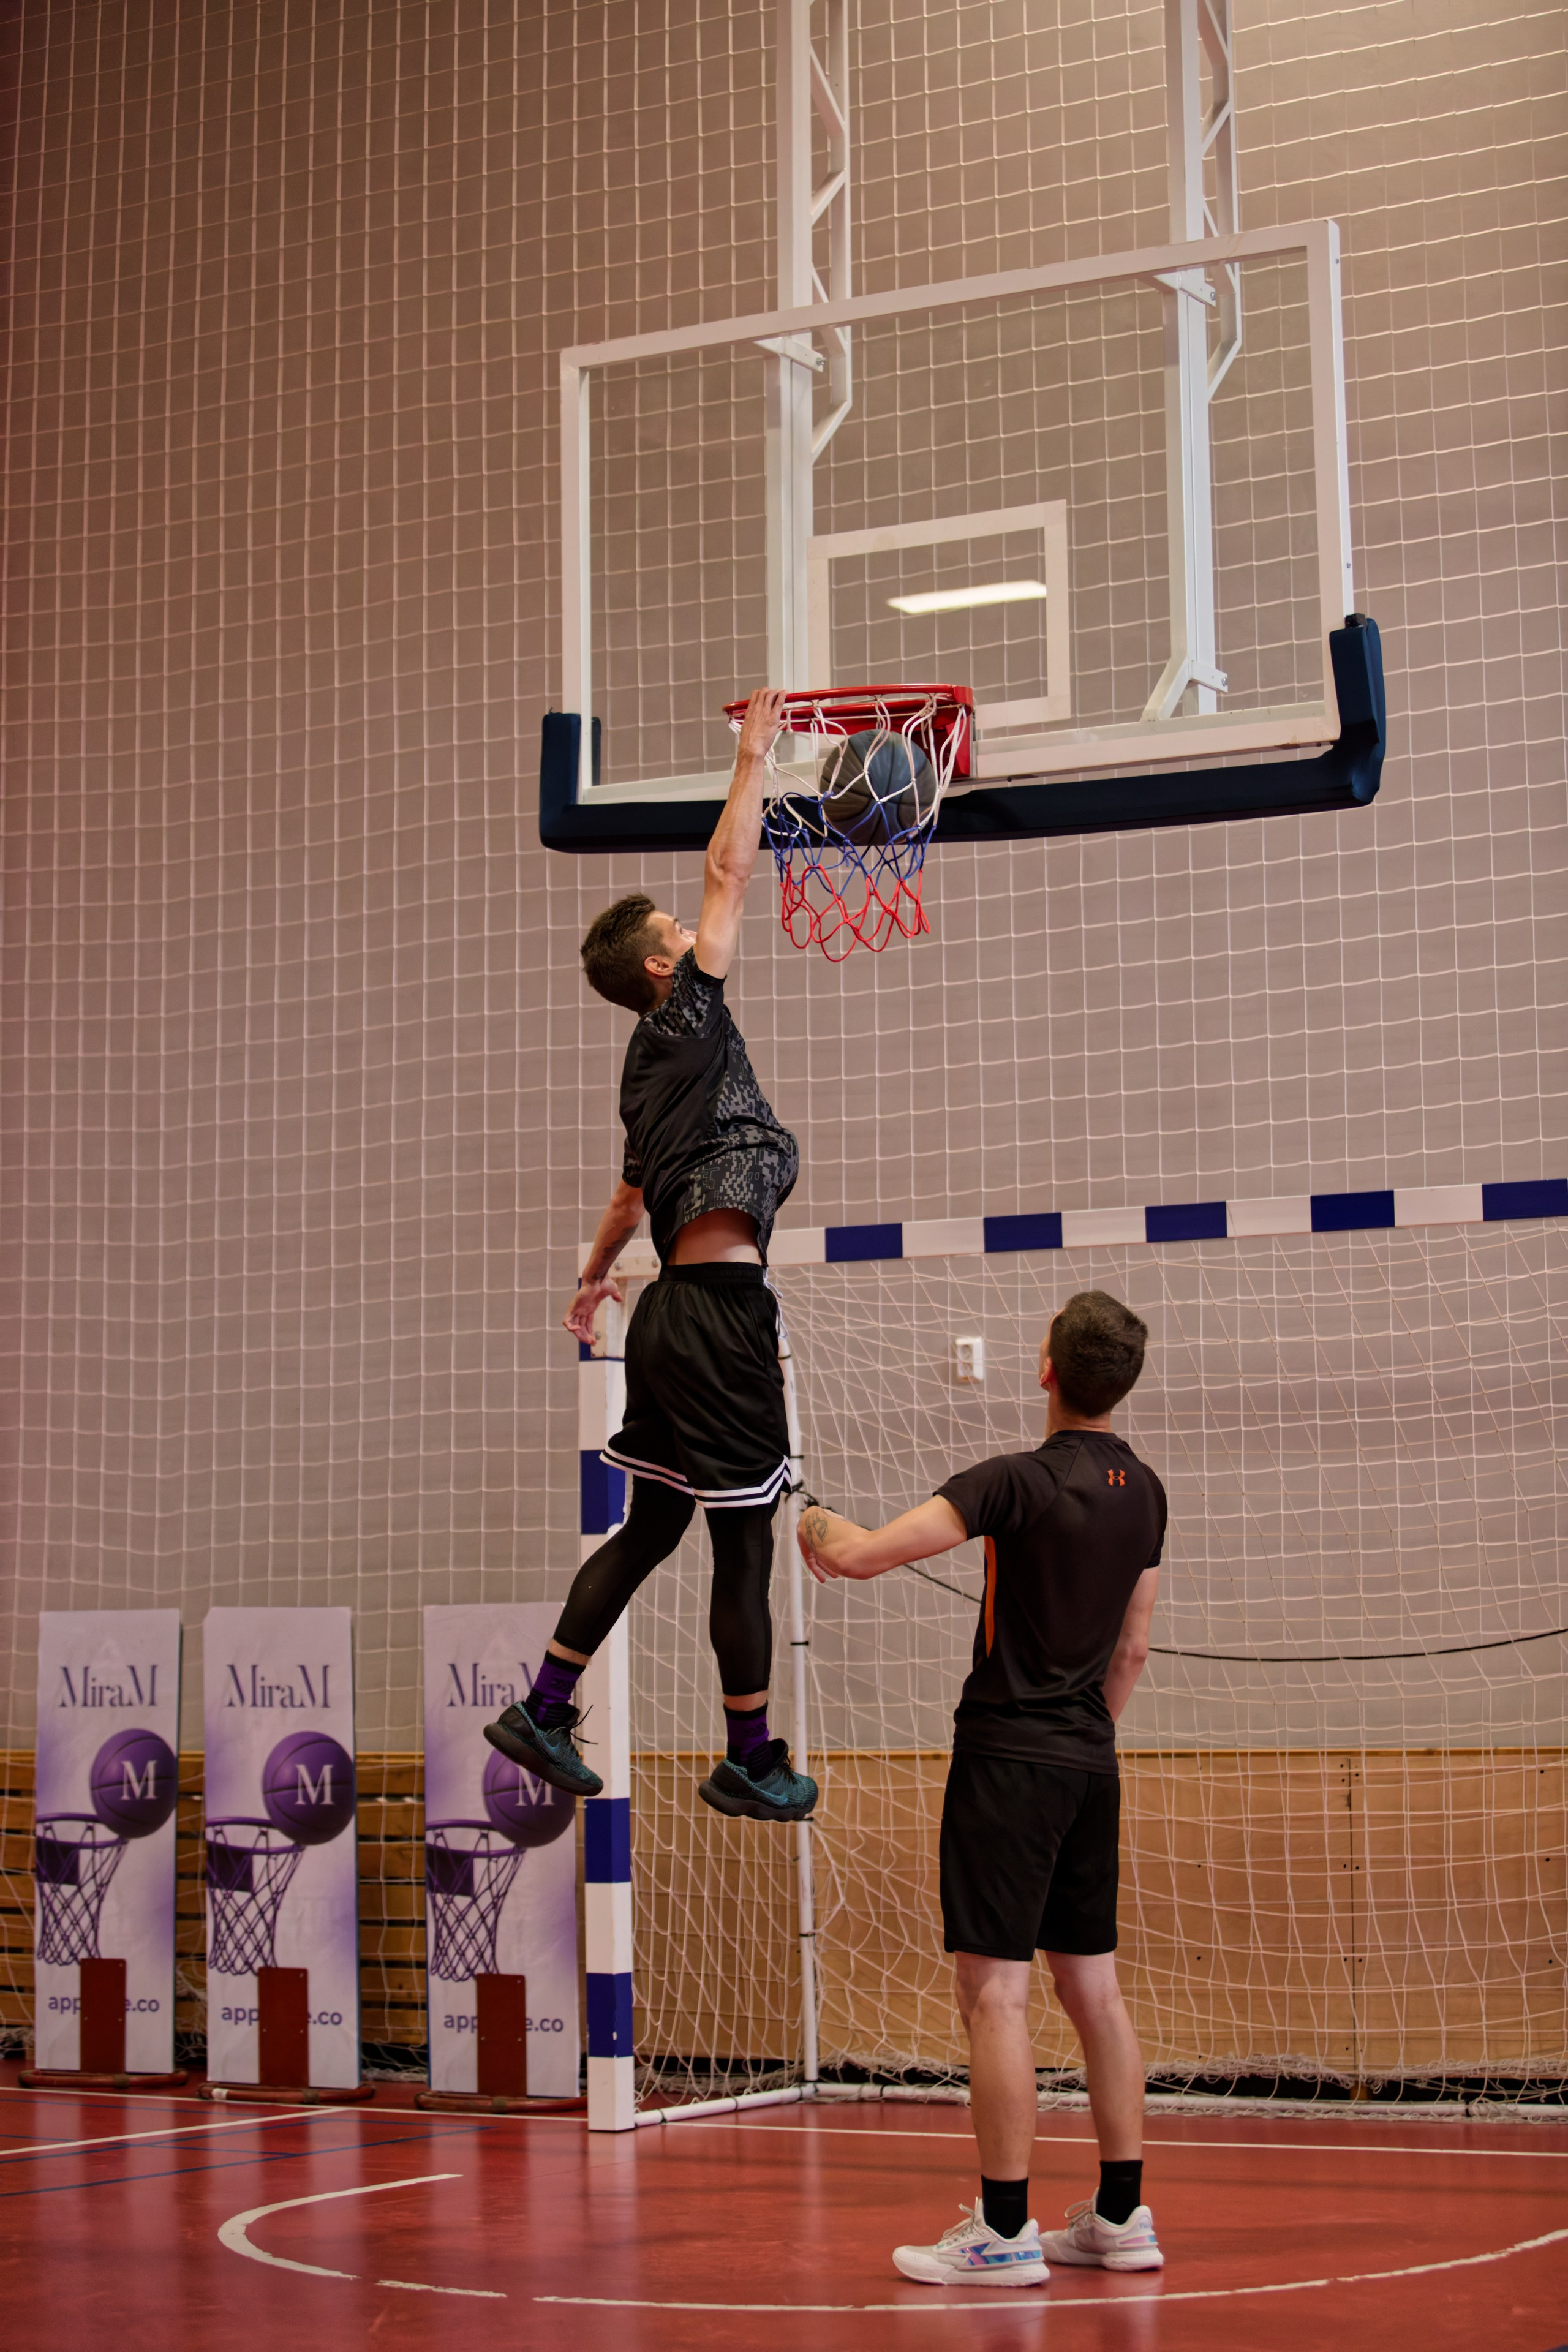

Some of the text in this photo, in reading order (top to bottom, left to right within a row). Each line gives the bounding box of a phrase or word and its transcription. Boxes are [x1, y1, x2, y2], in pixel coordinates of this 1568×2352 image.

[60, 1665, 157, 1707] MiraM
[226, 1664, 330, 1708] MiraM
[120, 1760, 157, 1800] M
[295, 1764, 334, 1805] M
[515, 1765, 555, 1806] M
